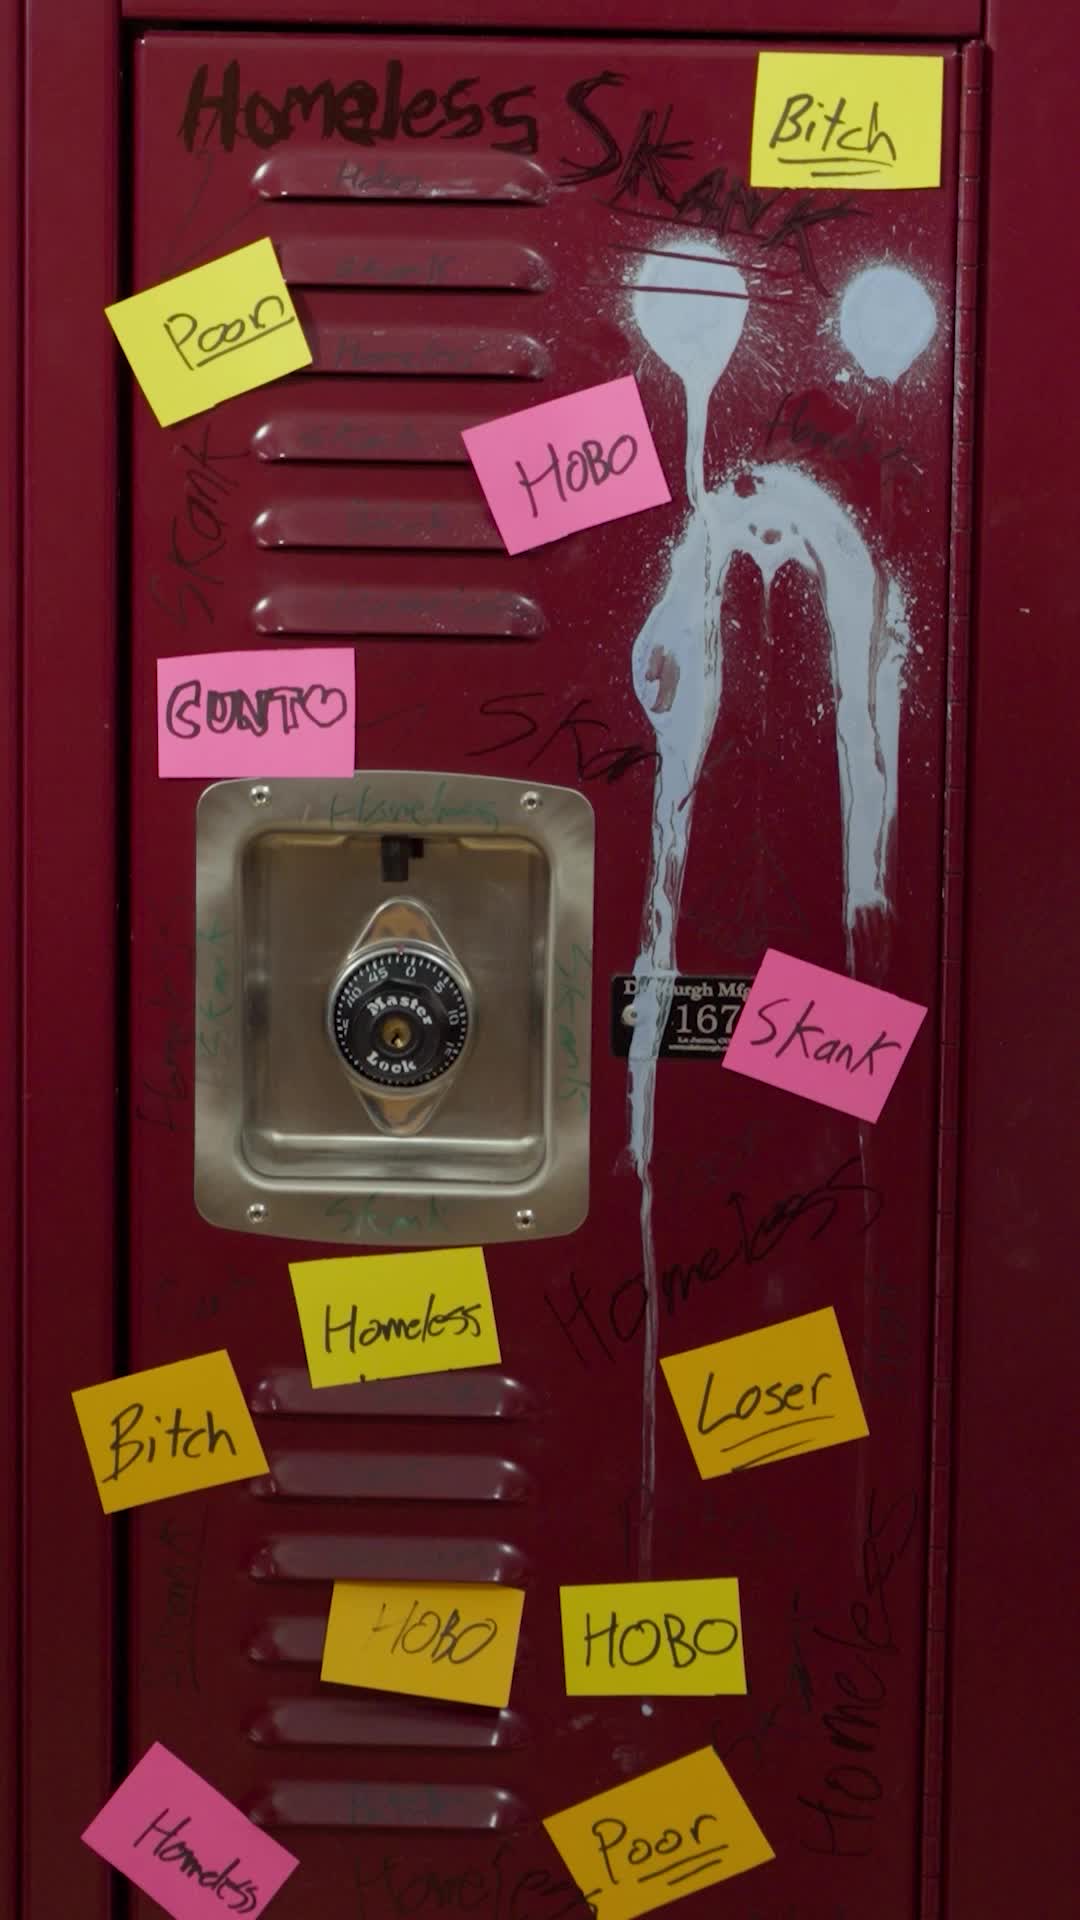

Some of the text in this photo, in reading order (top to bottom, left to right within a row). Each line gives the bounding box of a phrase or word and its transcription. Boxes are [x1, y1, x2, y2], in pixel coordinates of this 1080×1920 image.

[177, 57, 541, 154] Homeless
[768, 93, 896, 160] Bitch
[164, 296, 284, 371] Poor
[515, 434, 637, 518] HOBO
[368, 967, 389, 982] 45
[405, 966, 416, 978] 0
[434, 980, 446, 993] 5
[367, 996, 433, 1024] Master
[675, 1003, 741, 1035] 167
[751, 999, 902, 1076] Skank
[366, 1051, 417, 1074] Lock
[323, 1291, 483, 1354] Homeless
[698, 1370, 833, 1436] Loser
[102, 1402, 237, 1485] Bitch
[364, 1600, 498, 1665] HOBO
[583, 1611, 739, 1669] HOBO
[133, 1808, 259, 1914] Homeless
[592, 1810, 720, 1886] Poor
